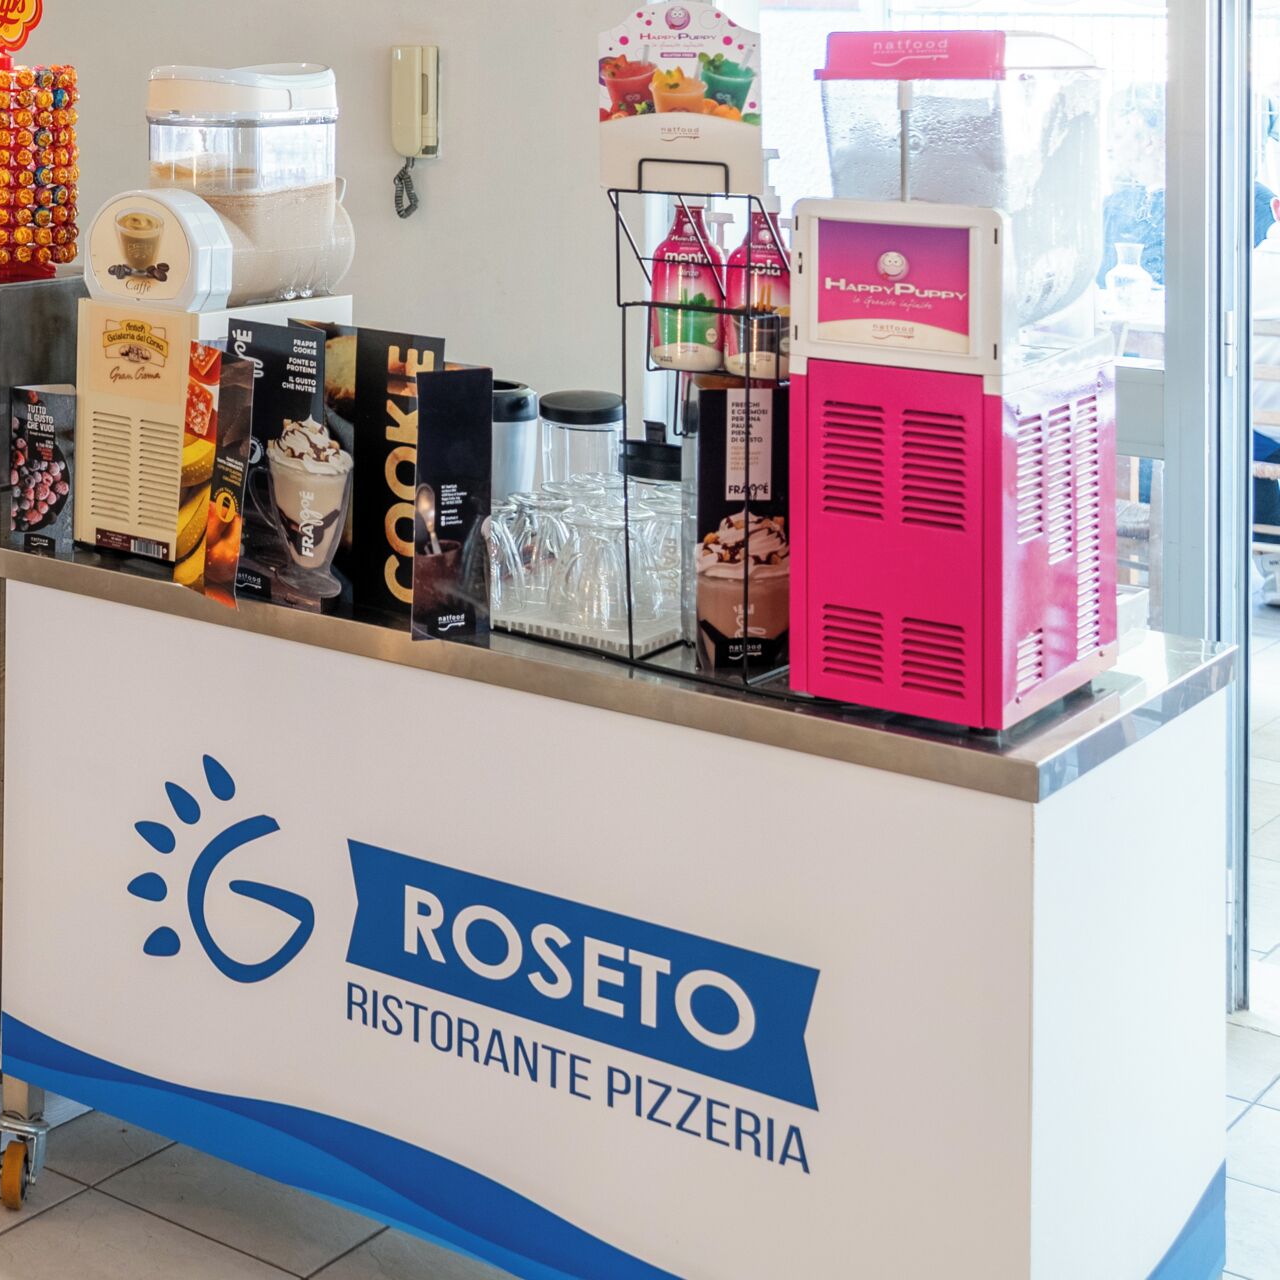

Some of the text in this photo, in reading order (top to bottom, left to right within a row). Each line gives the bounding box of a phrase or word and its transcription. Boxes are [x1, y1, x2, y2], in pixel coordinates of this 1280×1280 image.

[872, 38, 949, 50] natfood
[125, 279, 152, 294] Caffè
[872, 323, 915, 333] natfood
[292, 346, 317, 356] COOKIE
[288, 357, 309, 366] FONTE
[109, 366, 133, 383] Gran
[286, 364, 317, 375] PROTEINE
[295, 377, 317, 386] GUSTO
[295, 383, 316, 394] NUTRE
[27, 404, 47, 415] TUTTO
[27, 412, 54, 424] IL GUSTO
[26, 420, 55, 432] CHE VUOI
[383, 344, 435, 605] COOKIE
[438, 614, 465, 622] natfood
[402, 883, 757, 1052] ROSETO
[346, 980, 811, 1175] RISTORANTE PIZZERIA
